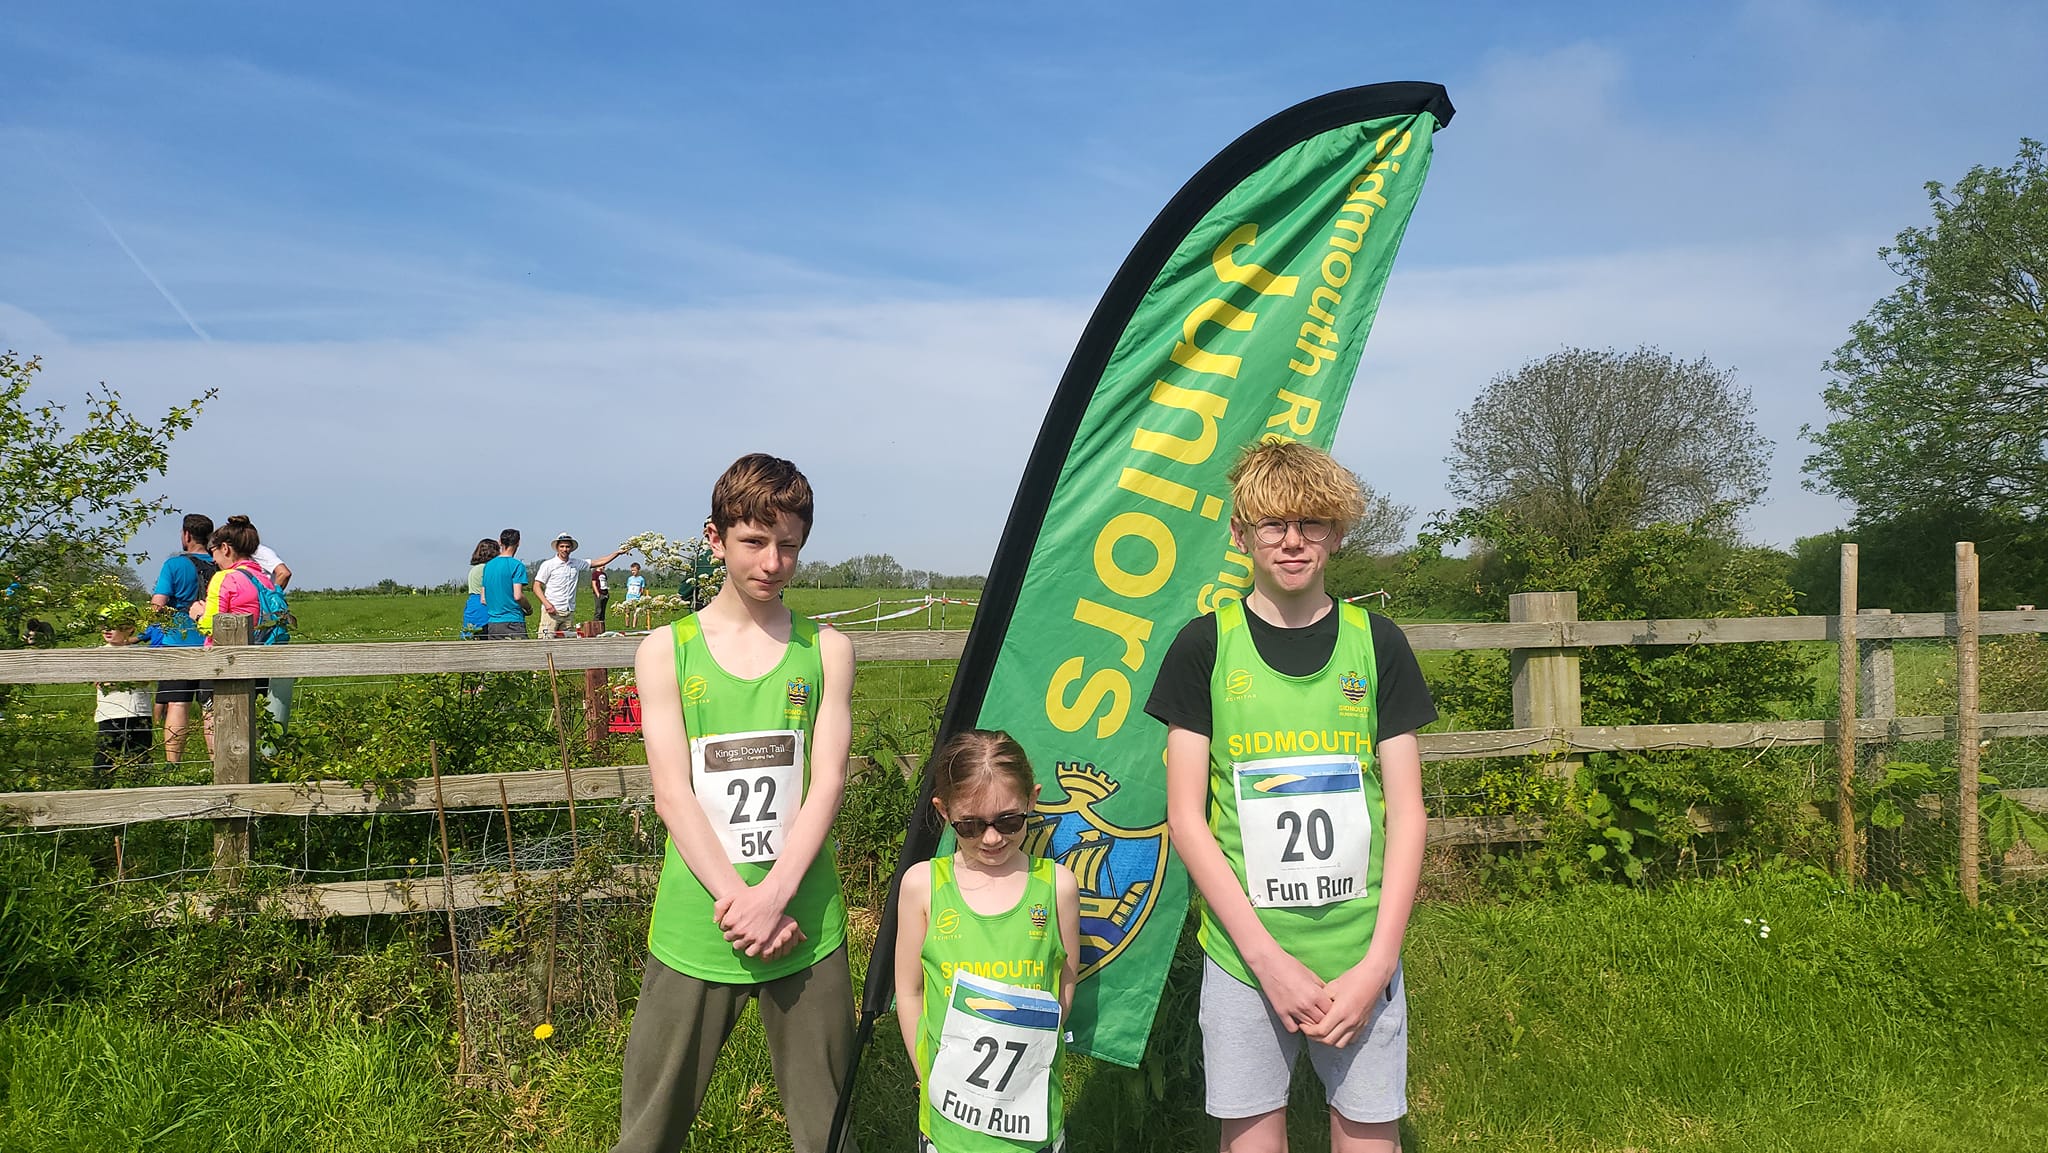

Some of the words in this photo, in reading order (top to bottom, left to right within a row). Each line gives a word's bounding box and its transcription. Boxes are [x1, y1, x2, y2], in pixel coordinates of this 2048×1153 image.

[1288, 128, 1412, 377] Sidmouth
[1046, 223, 1299, 739] Juniors
[715, 749, 738, 759] Kings
[741, 746, 768, 755] Down
[769, 744, 785, 753] Tail
[1228, 730, 1372, 756] SIDMOUTH
[727, 776, 777, 825] 22
[741, 830, 774, 857] 5K
[1276, 808, 1335, 863] 20
[1266, 878, 1308, 902] Fun
[1316, 874, 1354, 899] Run
[965, 1036, 1029, 1092] 27
[942, 1089, 981, 1126] Fun
[988, 1107, 1031, 1134] Run
